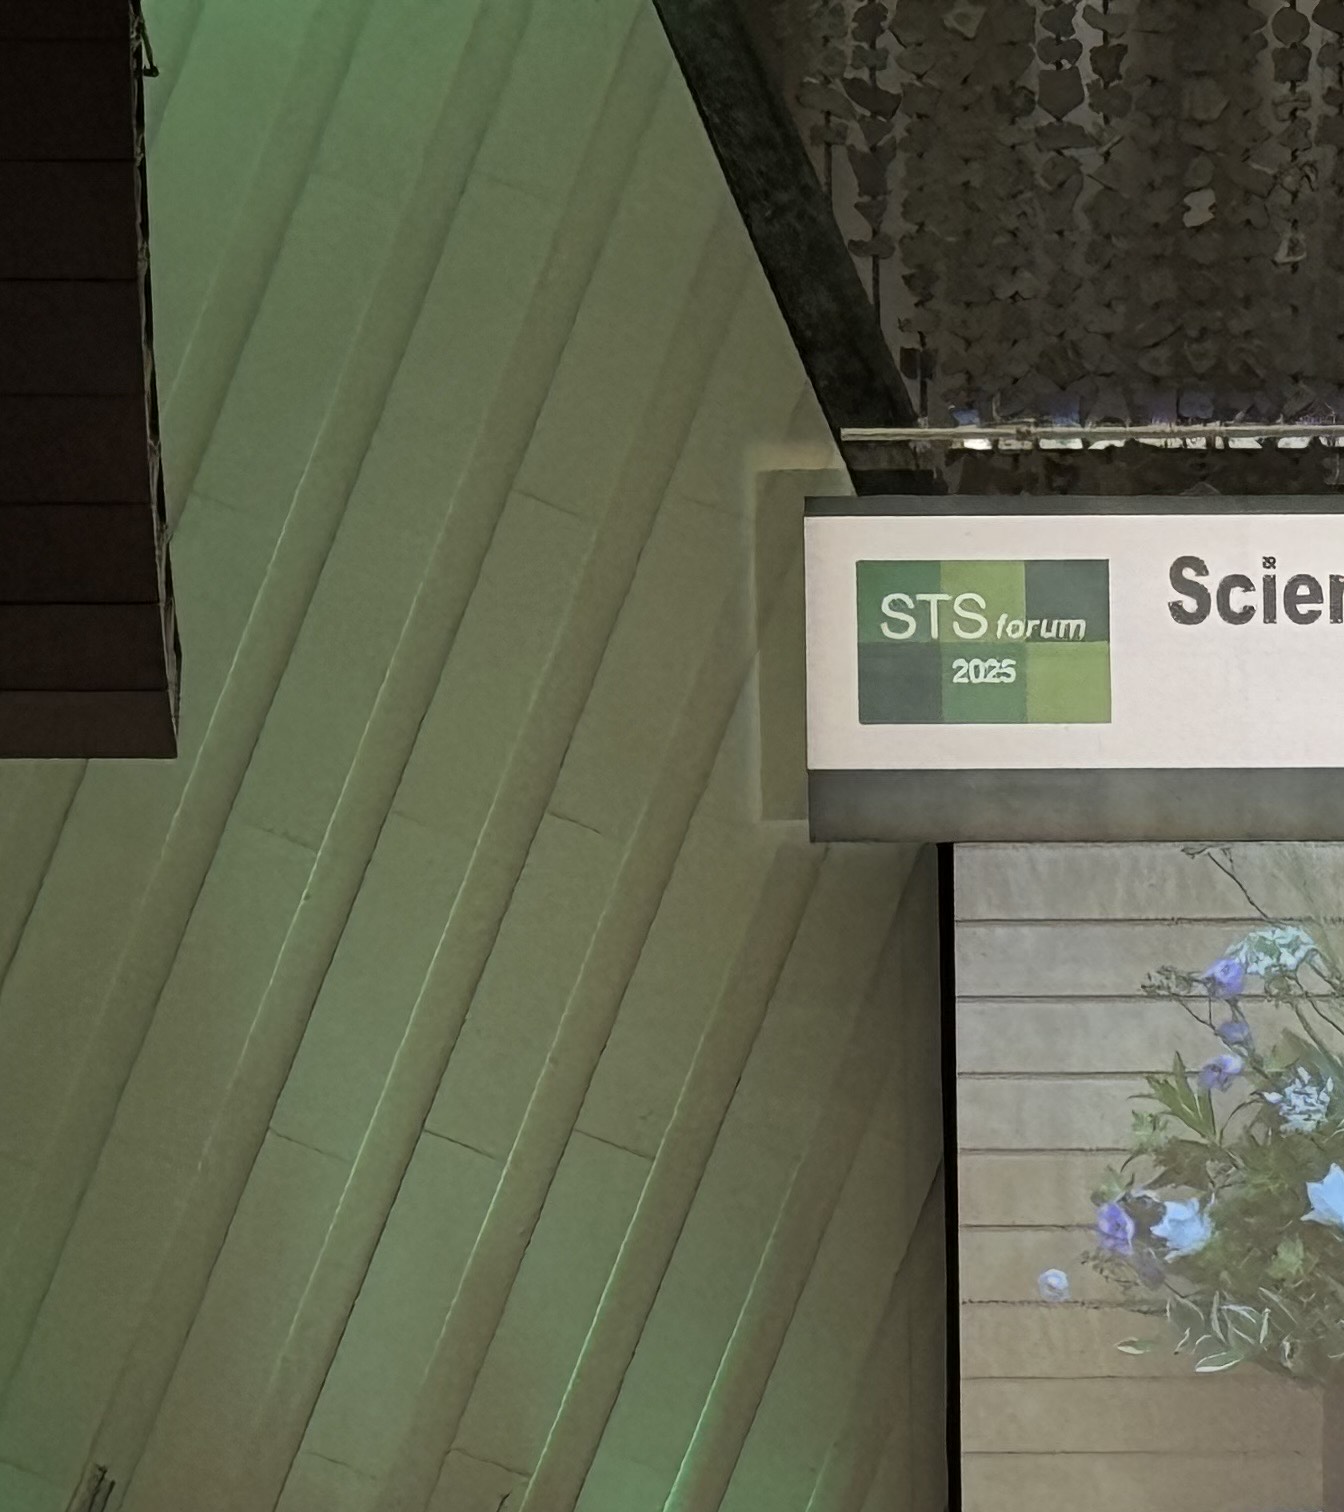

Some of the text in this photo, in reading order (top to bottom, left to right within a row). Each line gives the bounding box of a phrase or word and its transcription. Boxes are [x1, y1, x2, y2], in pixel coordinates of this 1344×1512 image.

[880, 592, 1087, 641] STS forum
[952, 658, 1018, 684] 2025
